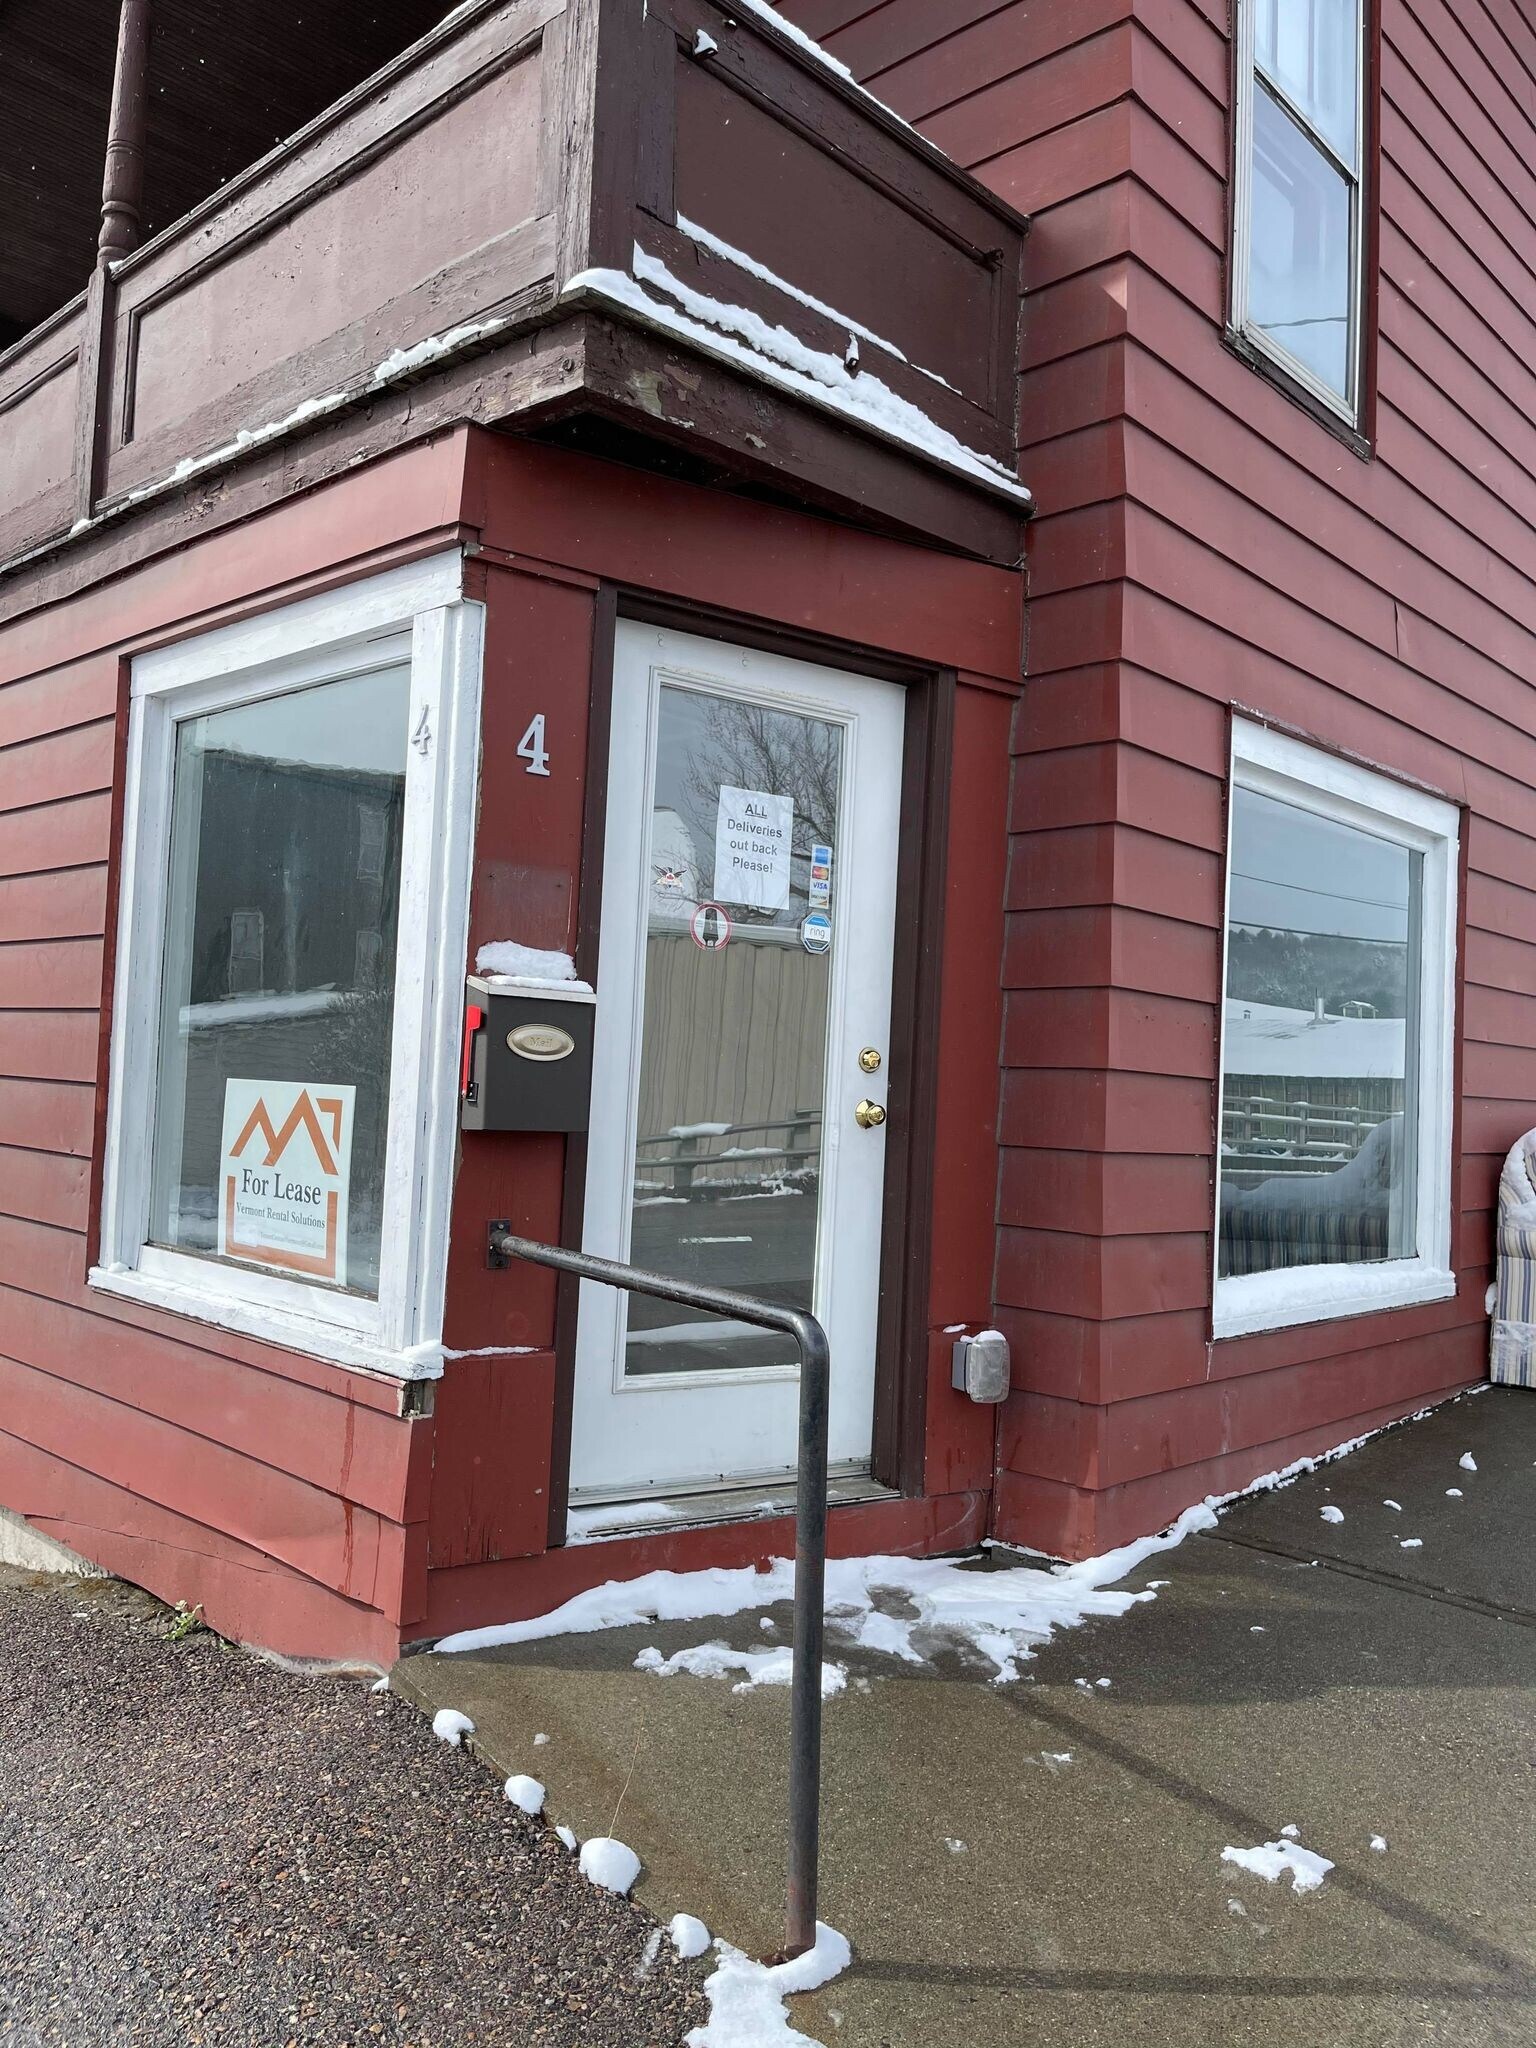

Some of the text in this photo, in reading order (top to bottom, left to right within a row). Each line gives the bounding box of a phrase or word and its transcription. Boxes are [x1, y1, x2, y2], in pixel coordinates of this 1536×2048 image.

[411, 704, 431, 754] 4
[517, 713, 550, 776] 4
[744, 803, 768, 818] ALL
[727, 819, 783, 838] Deliveries
[730, 840, 778, 856] out back
[732, 857, 773, 873] Please!
[813, 882, 828, 890] VISA
[810, 927, 825, 938] ring
[241, 1168, 321, 1205] For Lease
[236, 1201, 326, 1229] Vermont Rental Solutions
